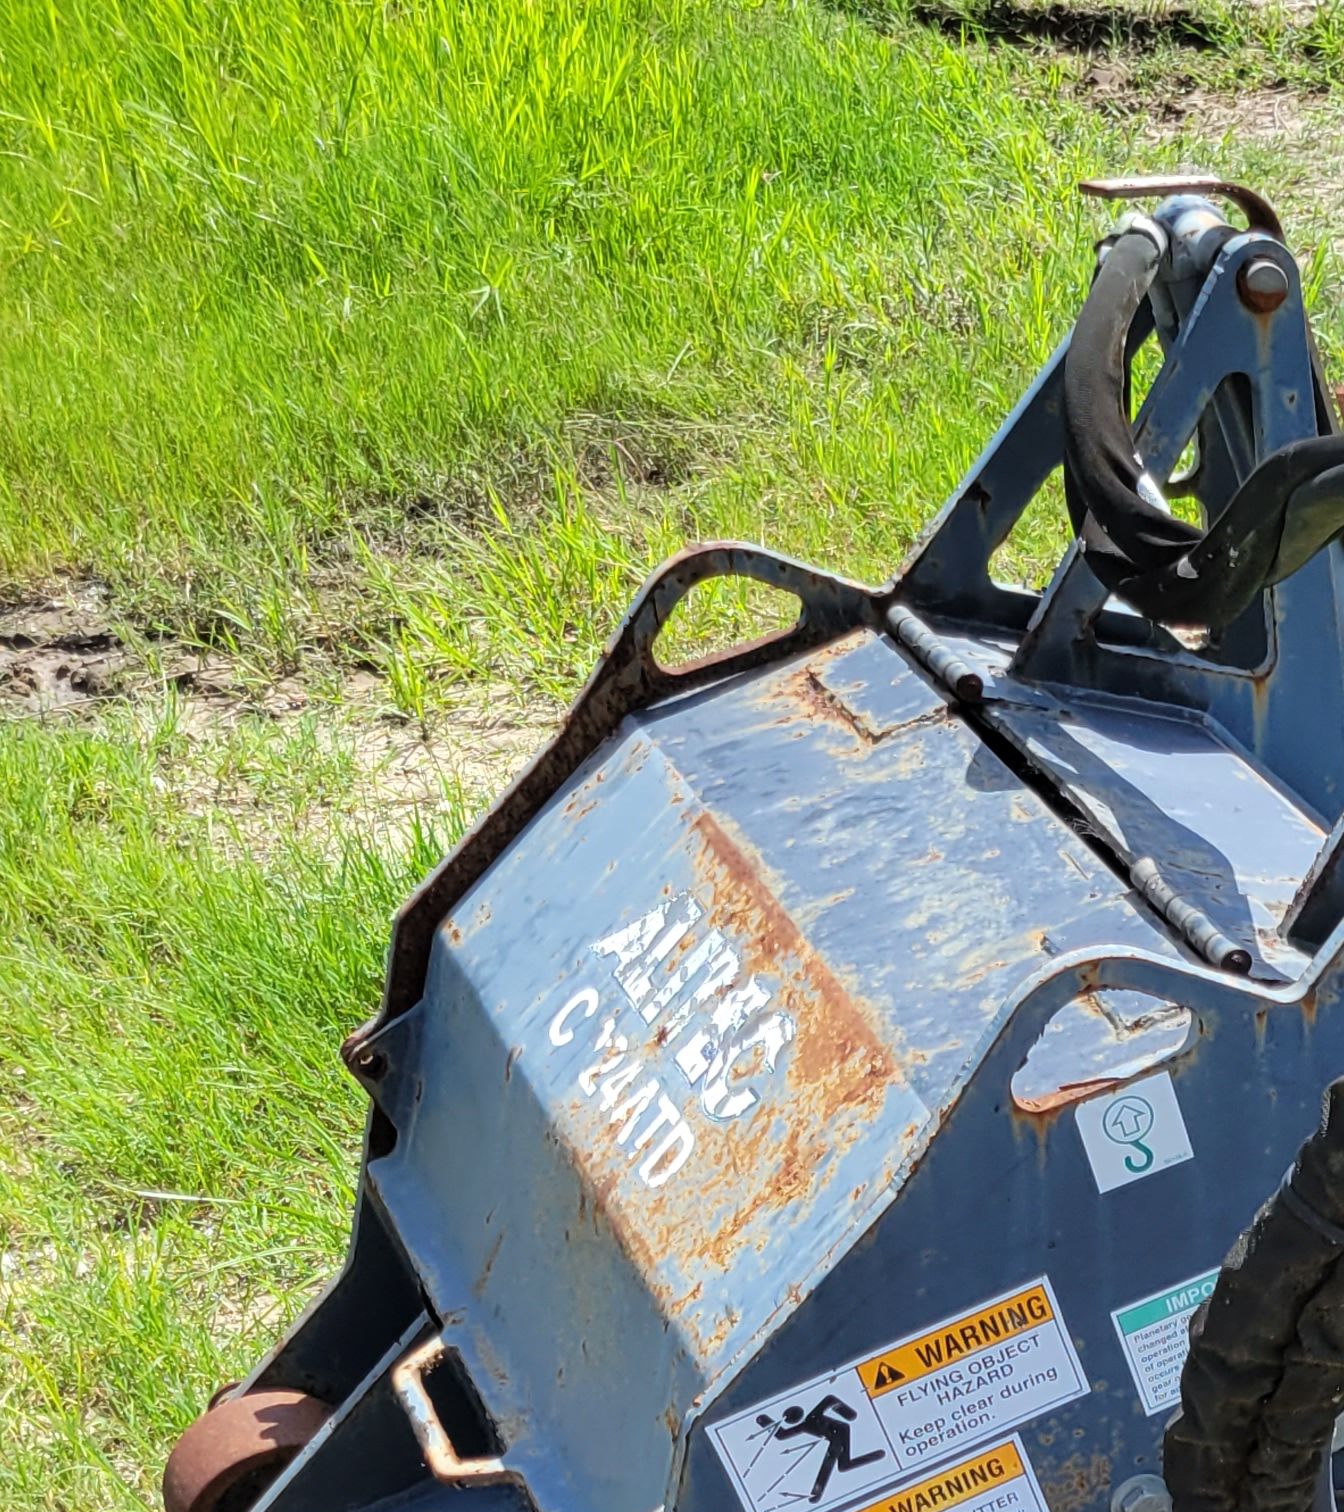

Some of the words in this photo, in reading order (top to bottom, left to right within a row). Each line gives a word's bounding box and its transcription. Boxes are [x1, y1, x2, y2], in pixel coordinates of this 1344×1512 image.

[1165, 1281, 1215, 1313] IMPO
[914, 1295, 1047, 1368] WARNING
[1133, 1319, 1178, 1344] Planetary
[1137, 1330, 1178, 1353] changed
[1141, 1340, 1186, 1363] operation
[896, 1370, 963, 1407] FLYING
[968, 1334, 1041, 1375] OBJECT
[1145, 1364, 1155, 1373] of
[1148, 1365, 1180, 1383] occurs
[937, 1363, 1014, 1406] HAZARD
[1152, 1379, 1172, 1394] gear
[1154, 1391, 1168, 1402] for
[899, 1417, 946, 1445] Keep
[951, 1395, 995, 1421] clear
[1000, 1367, 1058, 1400] during
[905, 1413, 996, 1457] operation.
